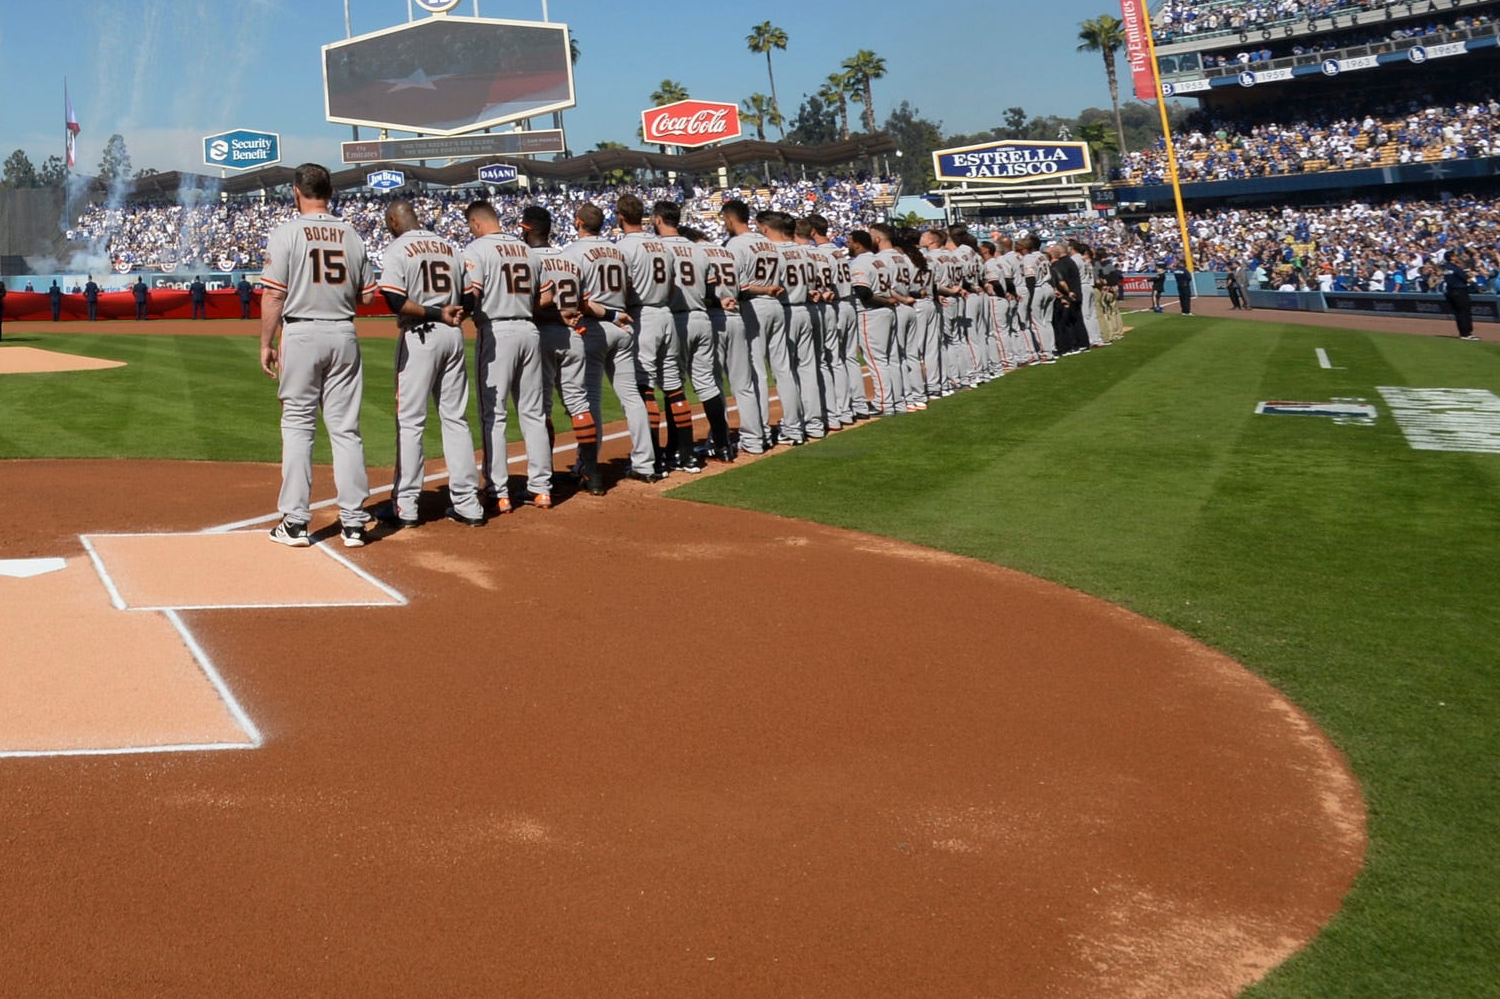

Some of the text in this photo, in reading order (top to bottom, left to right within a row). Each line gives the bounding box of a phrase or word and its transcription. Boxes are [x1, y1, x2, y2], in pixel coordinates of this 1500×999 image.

[1123, 0, 1146, 72] Fly Emirates
[1346, 58, 1370, 69] 1963
[1261, 70, 1286, 81] 1959
[1180, 81, 1204, 91] 1955
[651, 108, 730, 137] Coca-Cola
[231, 137, 272, 151] Security
[232, 149, 268, 161] Benefit
[951, 148, 1068, 167] ESTRELLA
[481, 169, 515, 179] DASANI
[966, 162, 1058, 178] JALISCO
[303, 226, 345, 244] BOCHY
[404, 240, 454, 258] JACKSON
[495, 244, 528, 258] PANIK
[673, 246, 693, 258] BELT
[309, 248, 346, 285] 15
[653, 257, 666, 284] 8
[680, 261, 696, 286] 9
[754, 257, 779, 285] 67
[419, 259, 452, 293] 16
[501, 262, 531, 294] 12
[598, 264, 621, 292] 10
